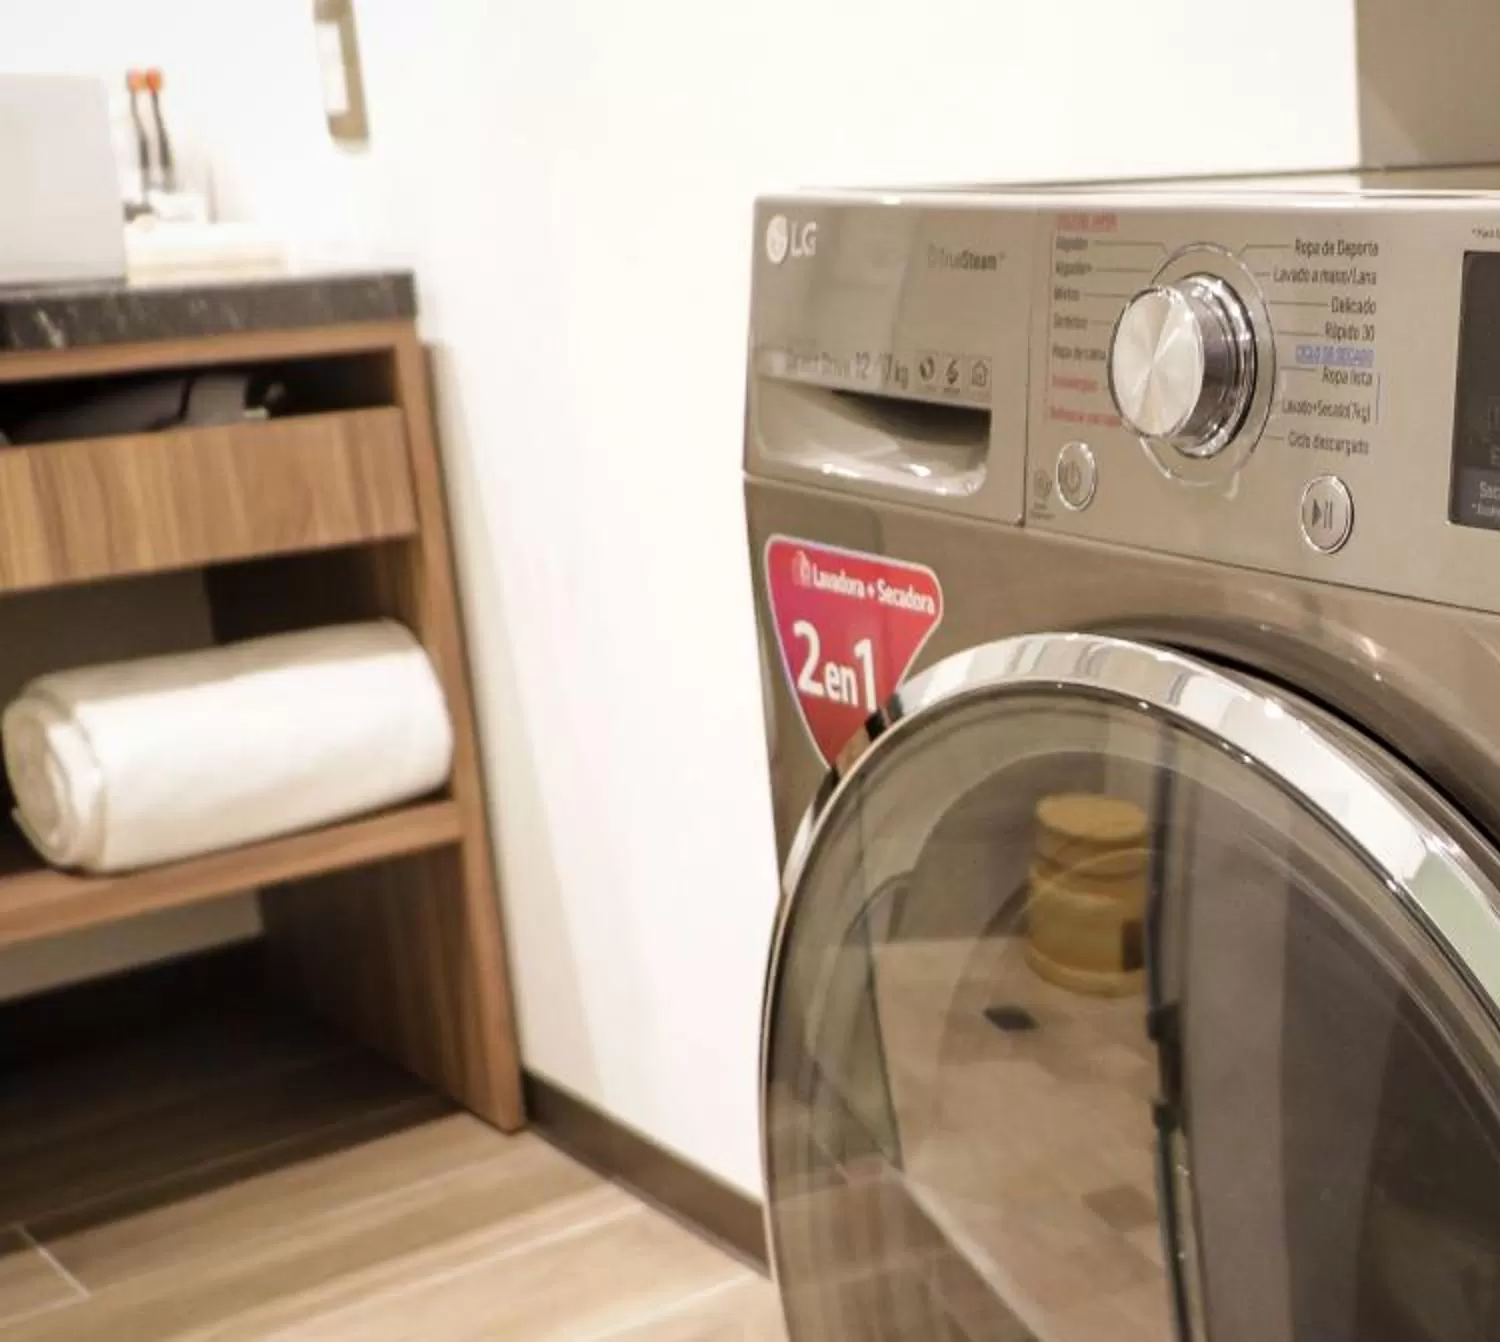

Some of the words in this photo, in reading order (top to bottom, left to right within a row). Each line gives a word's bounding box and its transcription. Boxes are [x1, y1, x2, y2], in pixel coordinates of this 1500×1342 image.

[790, 221, 818, 257] LG
[1331, 296, 1376, 315] Delicado
[813, 563, 865, 599] Lavadora
[867, 584, 876, 599] +
[876, 578, 936, 616] Secadora
